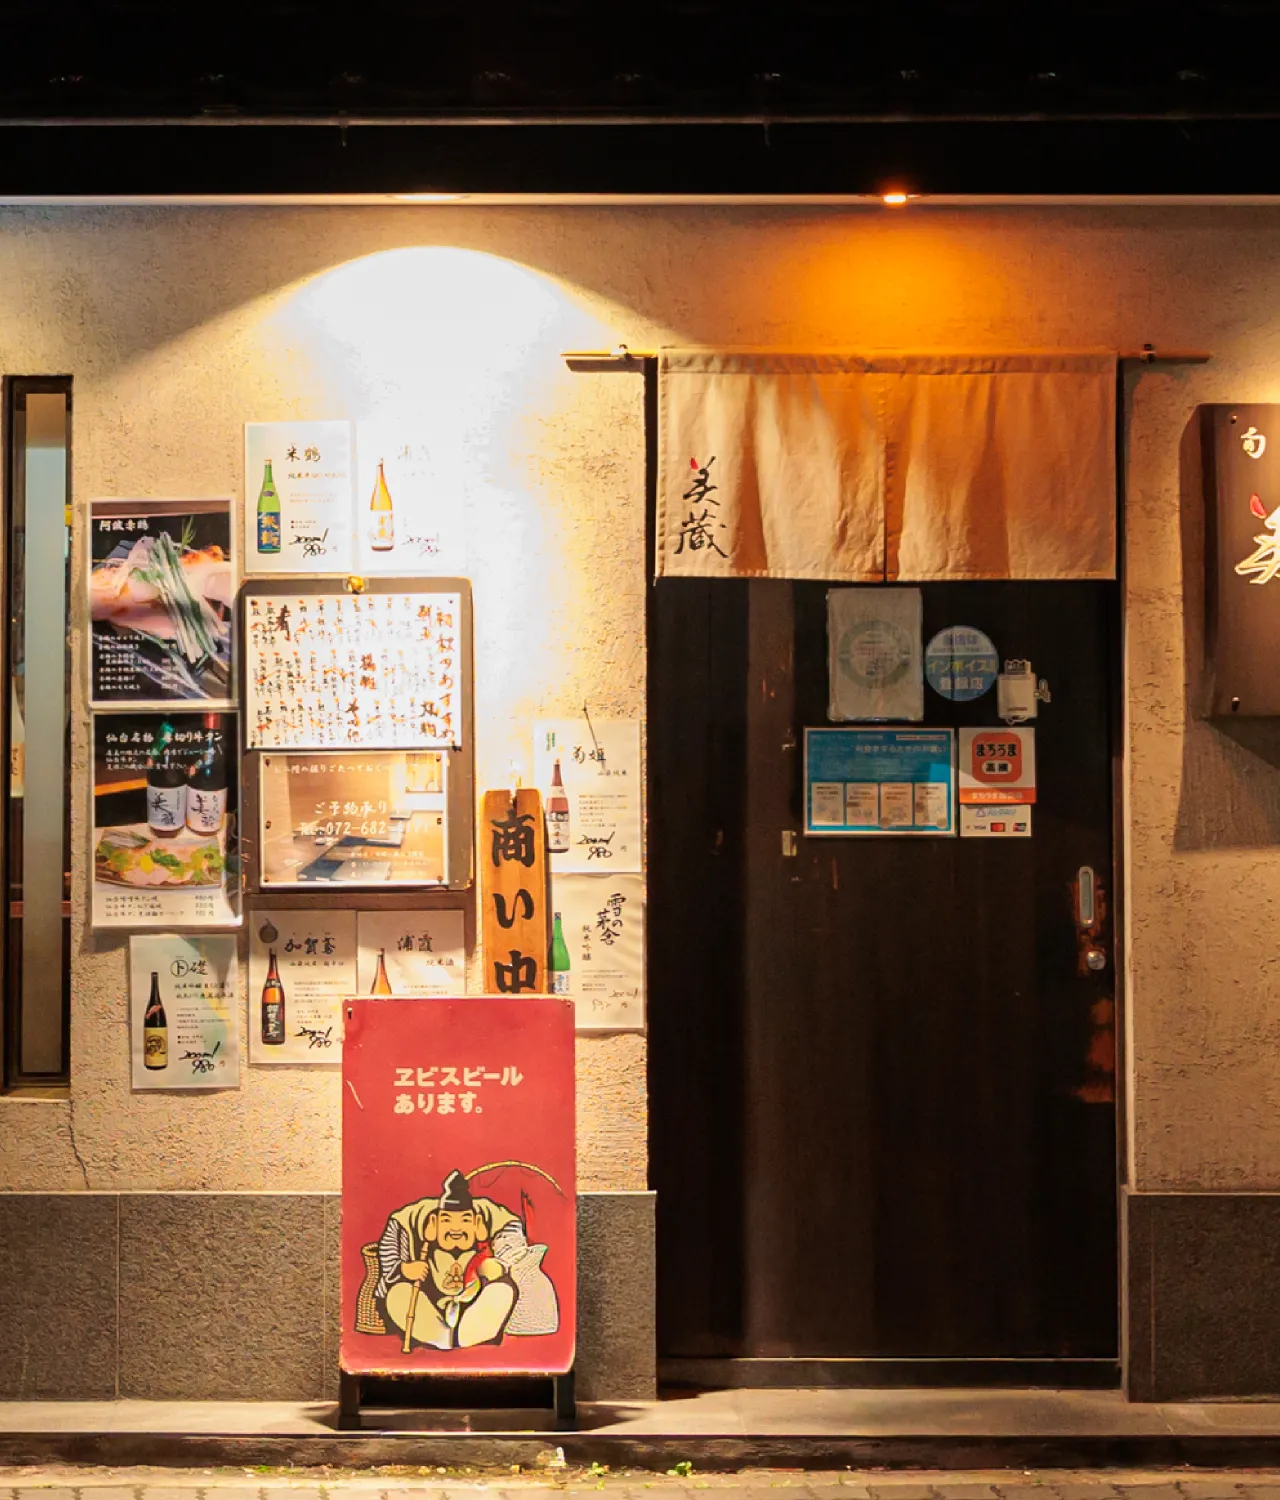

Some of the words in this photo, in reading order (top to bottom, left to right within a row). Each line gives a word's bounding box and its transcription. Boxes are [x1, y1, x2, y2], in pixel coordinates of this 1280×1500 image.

[674, 456, 729, 558] 美蔵
[976, 743, 1017, 757] まちうま
[490, 809, 540, 994] 商い中
[393, 1066, 524, 1088] ヱビスビール
[393, 1091, 484, 1115] あります。
